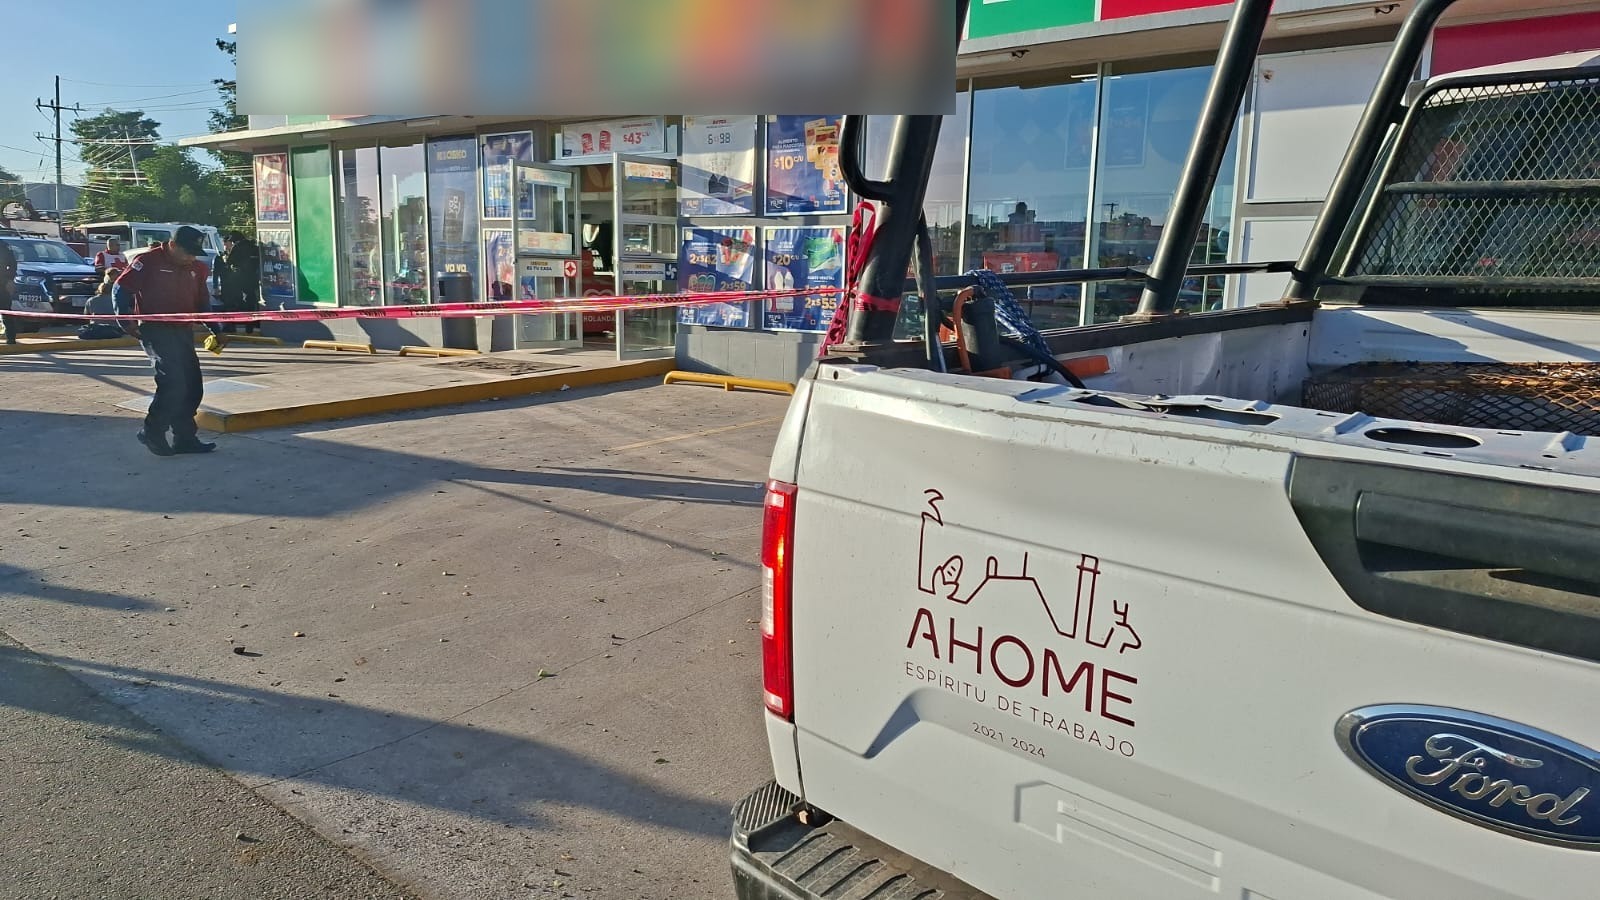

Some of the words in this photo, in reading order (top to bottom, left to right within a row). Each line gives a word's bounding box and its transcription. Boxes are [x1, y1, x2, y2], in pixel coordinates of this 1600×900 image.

[774, 155, 793, 170] $10
[772, 254, 790, 266] $20
[804, 297, 837, 310] 2x$55
[907, 607, 1138, 727] AHOME
[972, 722, 1004, 743] 2021
[1011, 737, 1046, 758] 2024
[998, 695, 1023, 717] DE
[1030, 706, 1135, 757] TRABAJO
[1405, 733, 1591, 826] Ford
